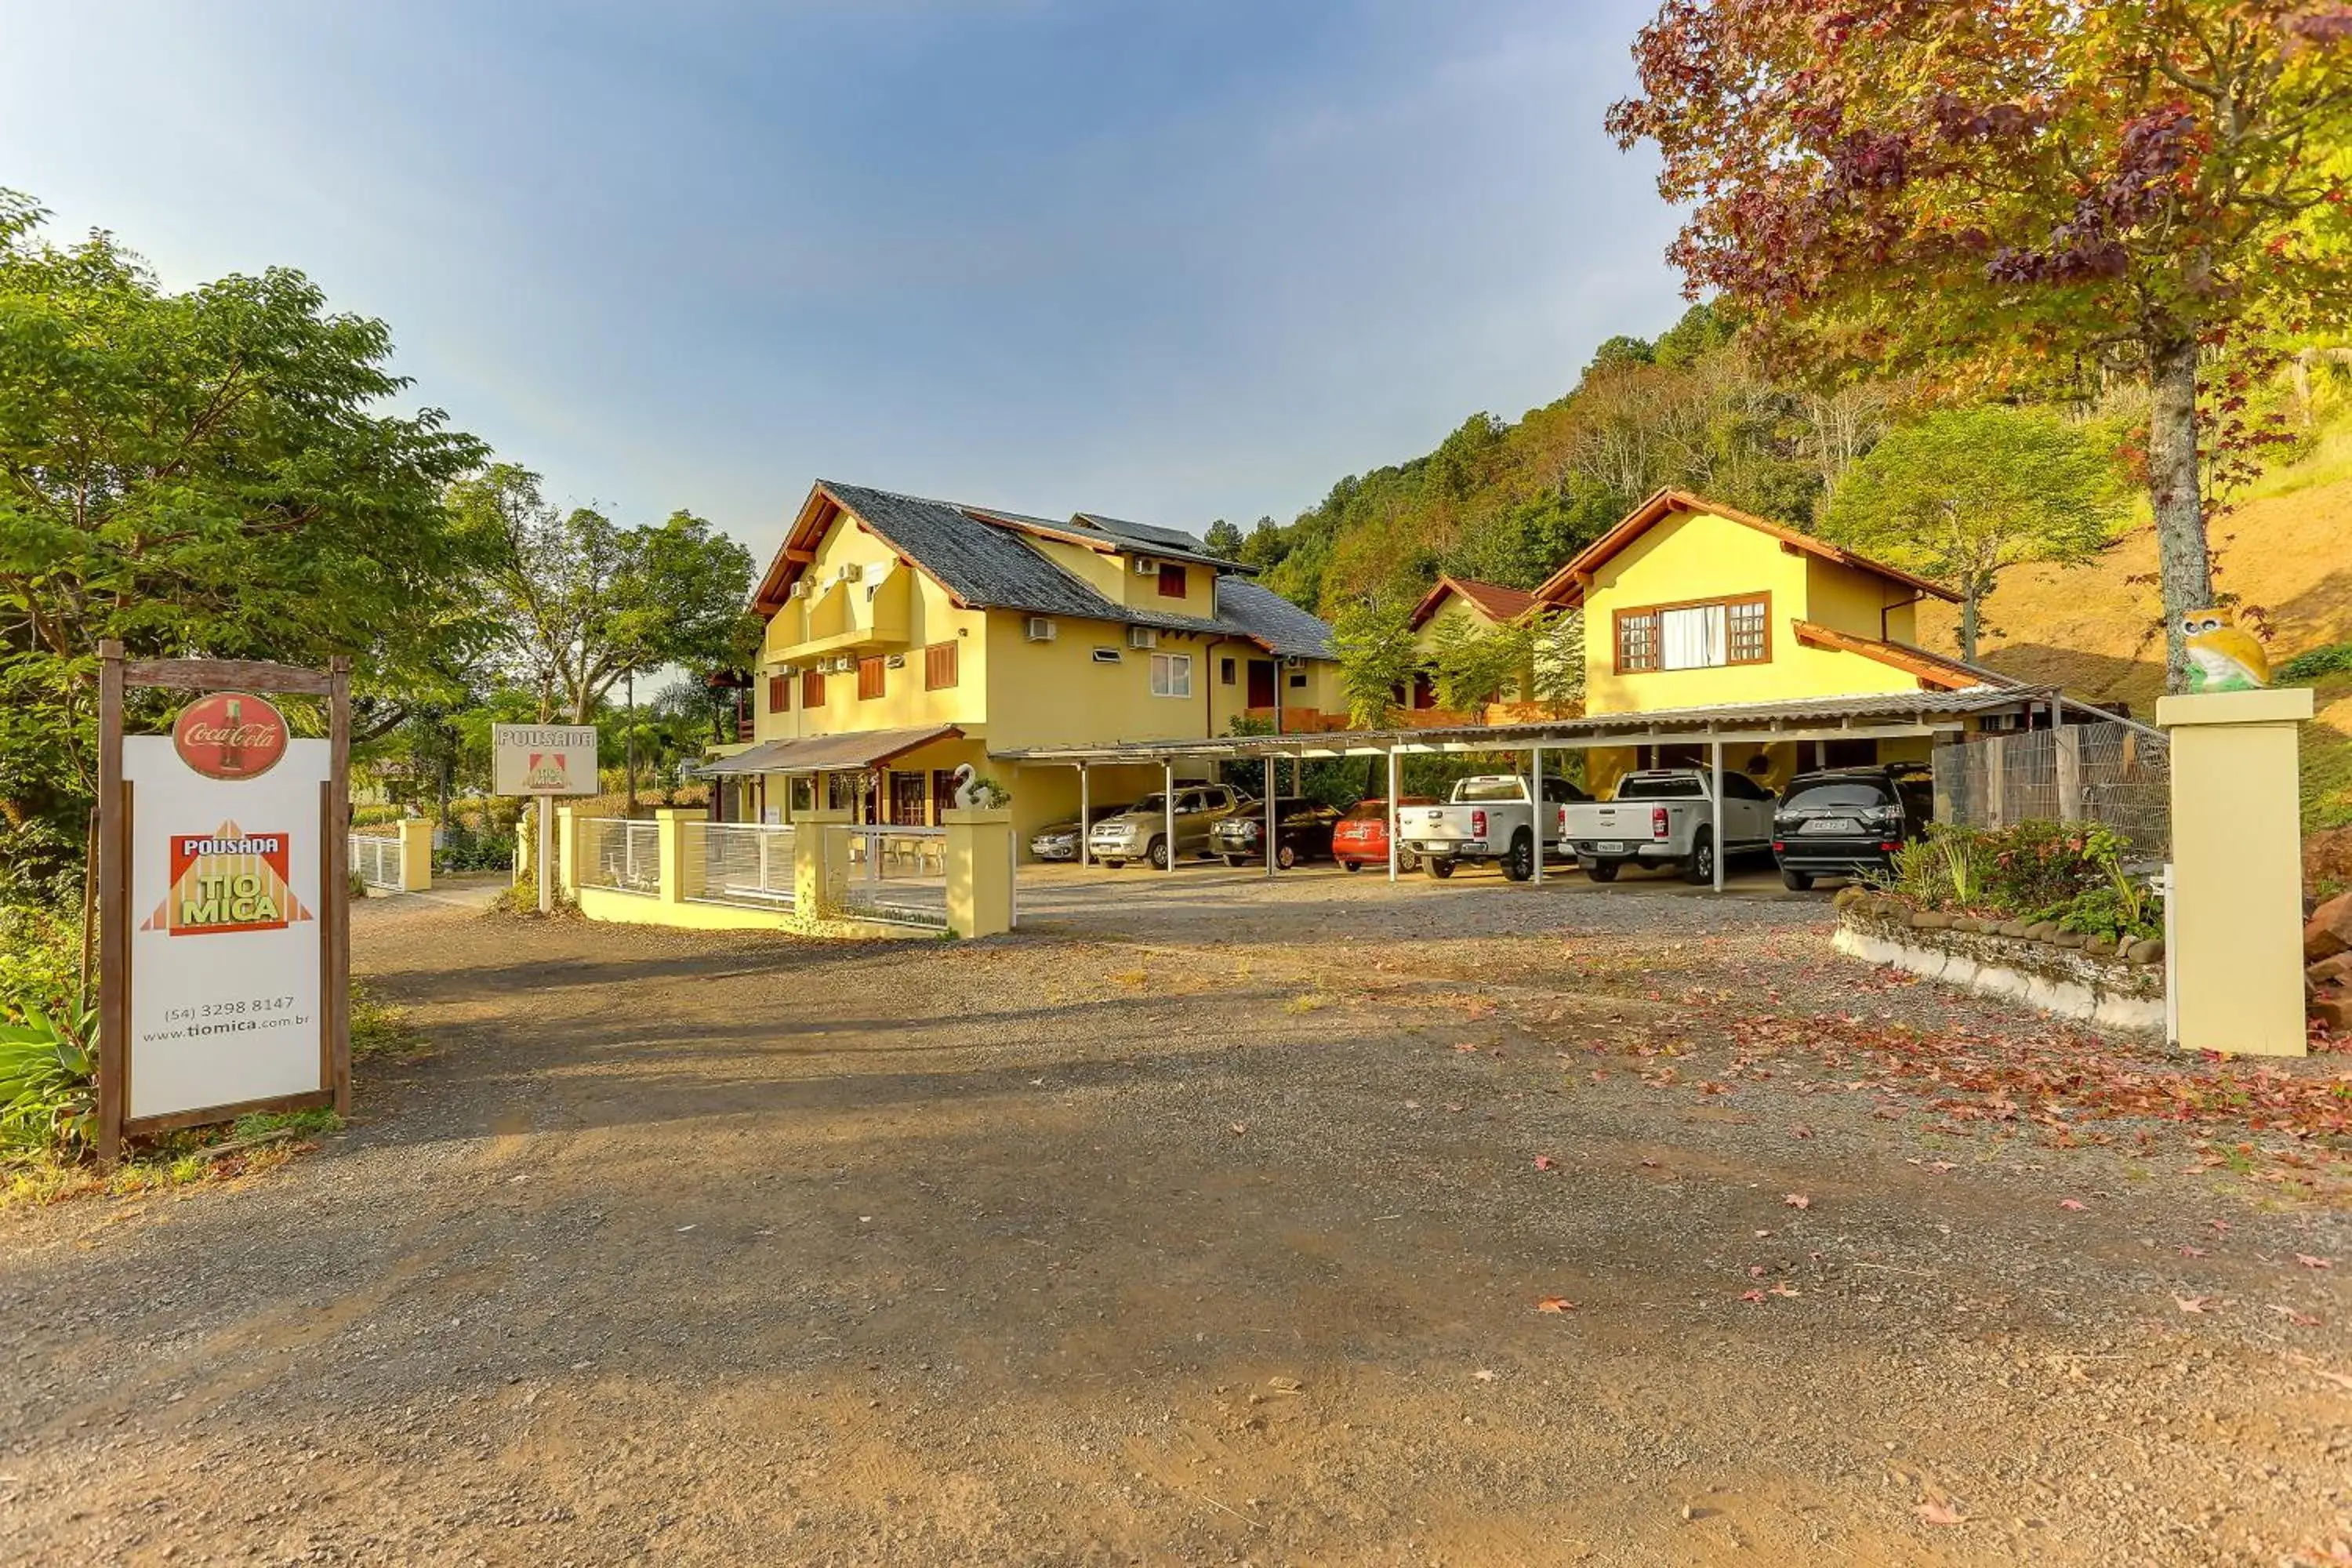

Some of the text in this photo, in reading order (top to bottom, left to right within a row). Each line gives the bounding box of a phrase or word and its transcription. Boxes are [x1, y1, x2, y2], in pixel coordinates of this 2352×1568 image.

[183, 838, 278, 855] POUSADA
[200, 874, 260, 899] TIO
[183, 895, 279, 924] MICA
[165, 996, 294, 1022] (54) 3298 8147
[143, 1014, 310, 1042] www.tiomica.com.br
